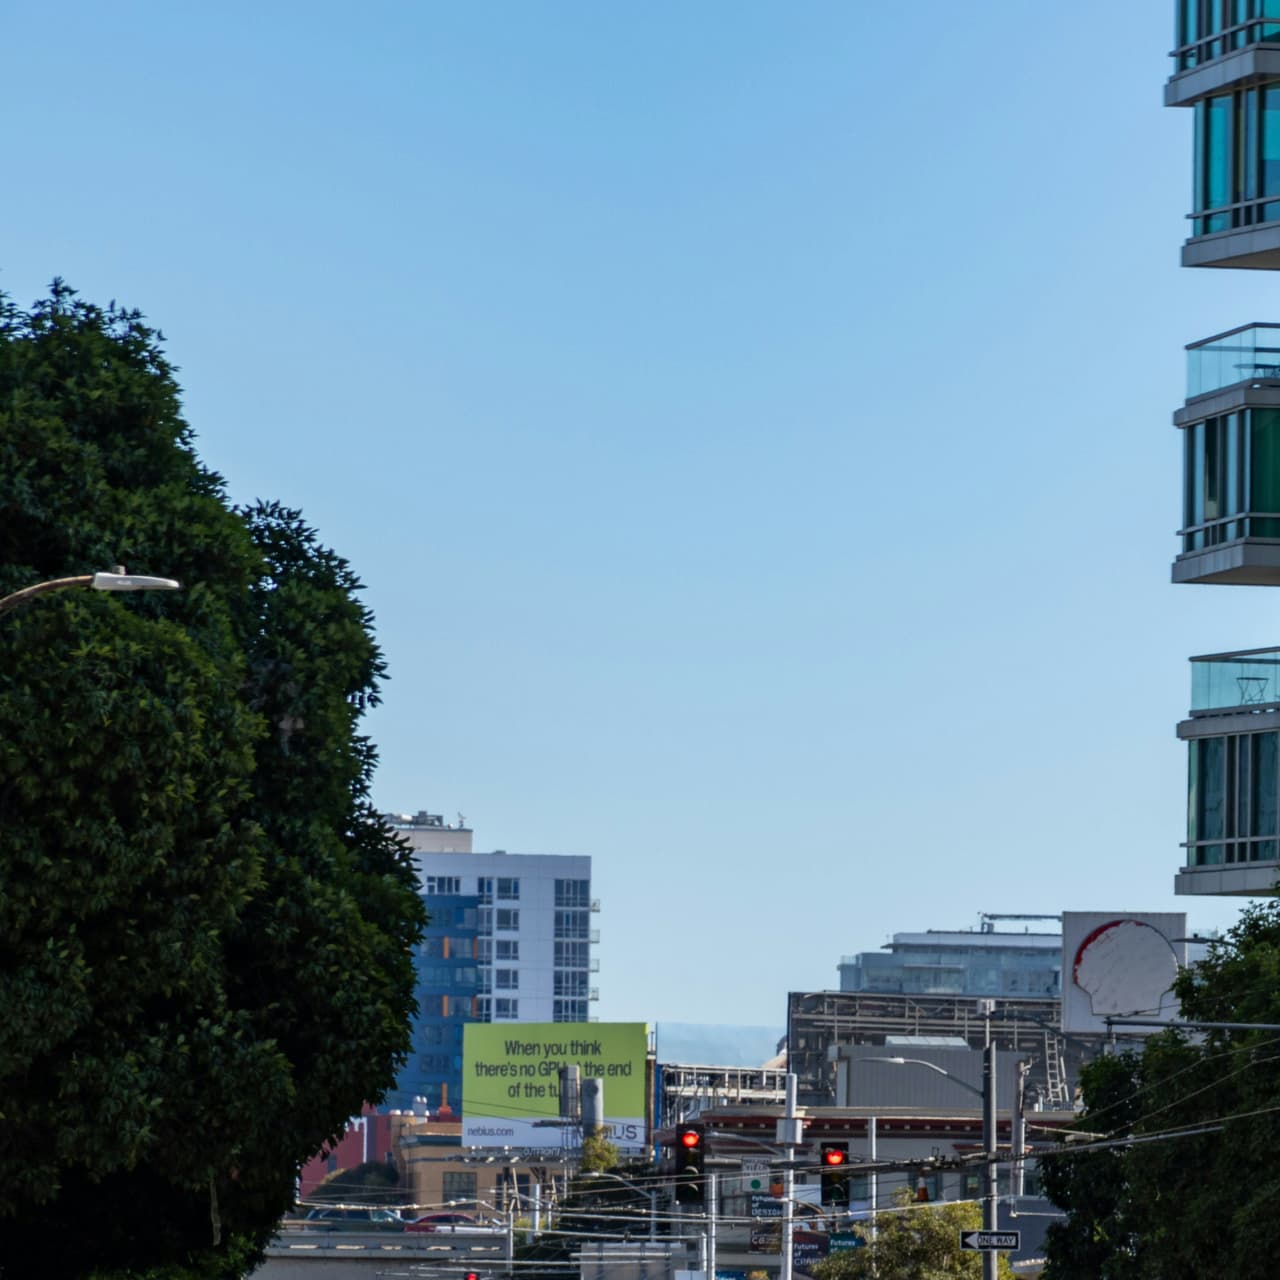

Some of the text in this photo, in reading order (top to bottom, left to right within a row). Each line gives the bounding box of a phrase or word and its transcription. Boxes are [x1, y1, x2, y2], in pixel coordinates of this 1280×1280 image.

[504, 1039, 602, 1059] When you think
[475, 1060, 518, 1077] there's
[520, 1064, 536, 1077] no
[583, 1060, 606, 1077] the
[607, 1060, 632, 1077] end
[507, 1082, 522, 1098] of
[524, 1082, 546, 1098] the
[467, 1126, 514, 1137] nebius.com
[996, 1235, 1014, 1246] WAY
